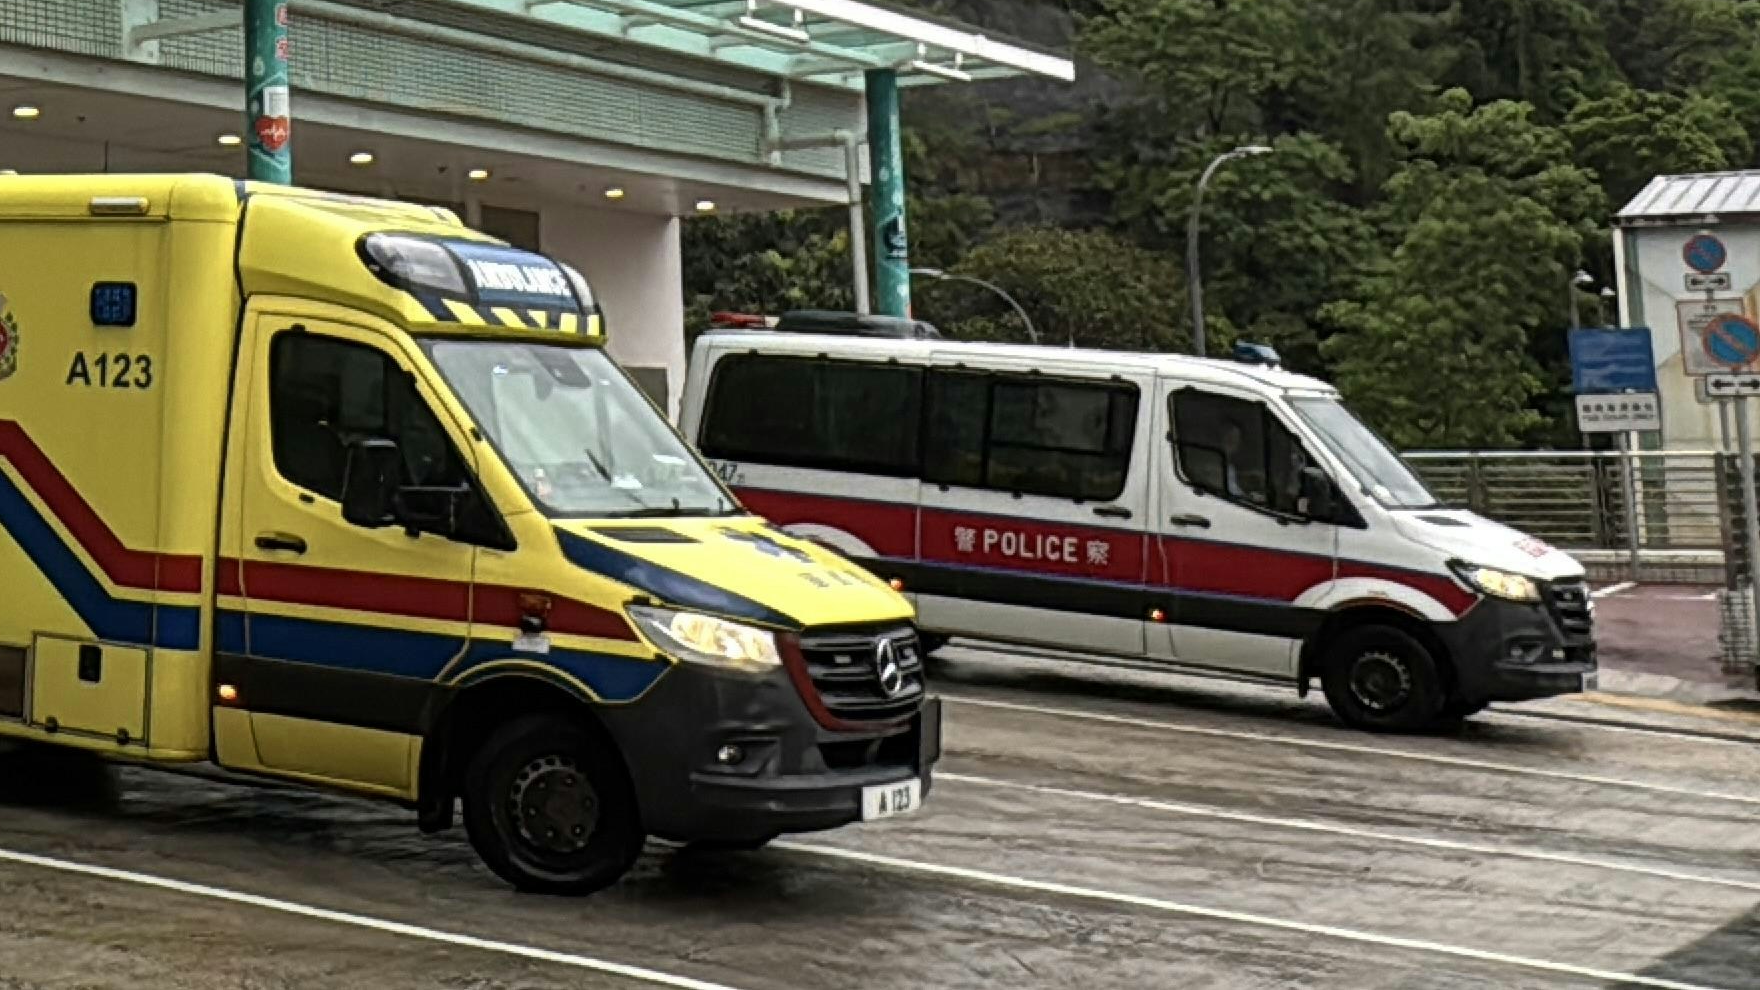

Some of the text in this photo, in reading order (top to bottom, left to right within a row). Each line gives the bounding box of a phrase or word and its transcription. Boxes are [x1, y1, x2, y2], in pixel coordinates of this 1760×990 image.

[65, 350, 153, 390] A123
[983, 528, 1079, 563] POLICE
[892, 785, 911, 811] 123
